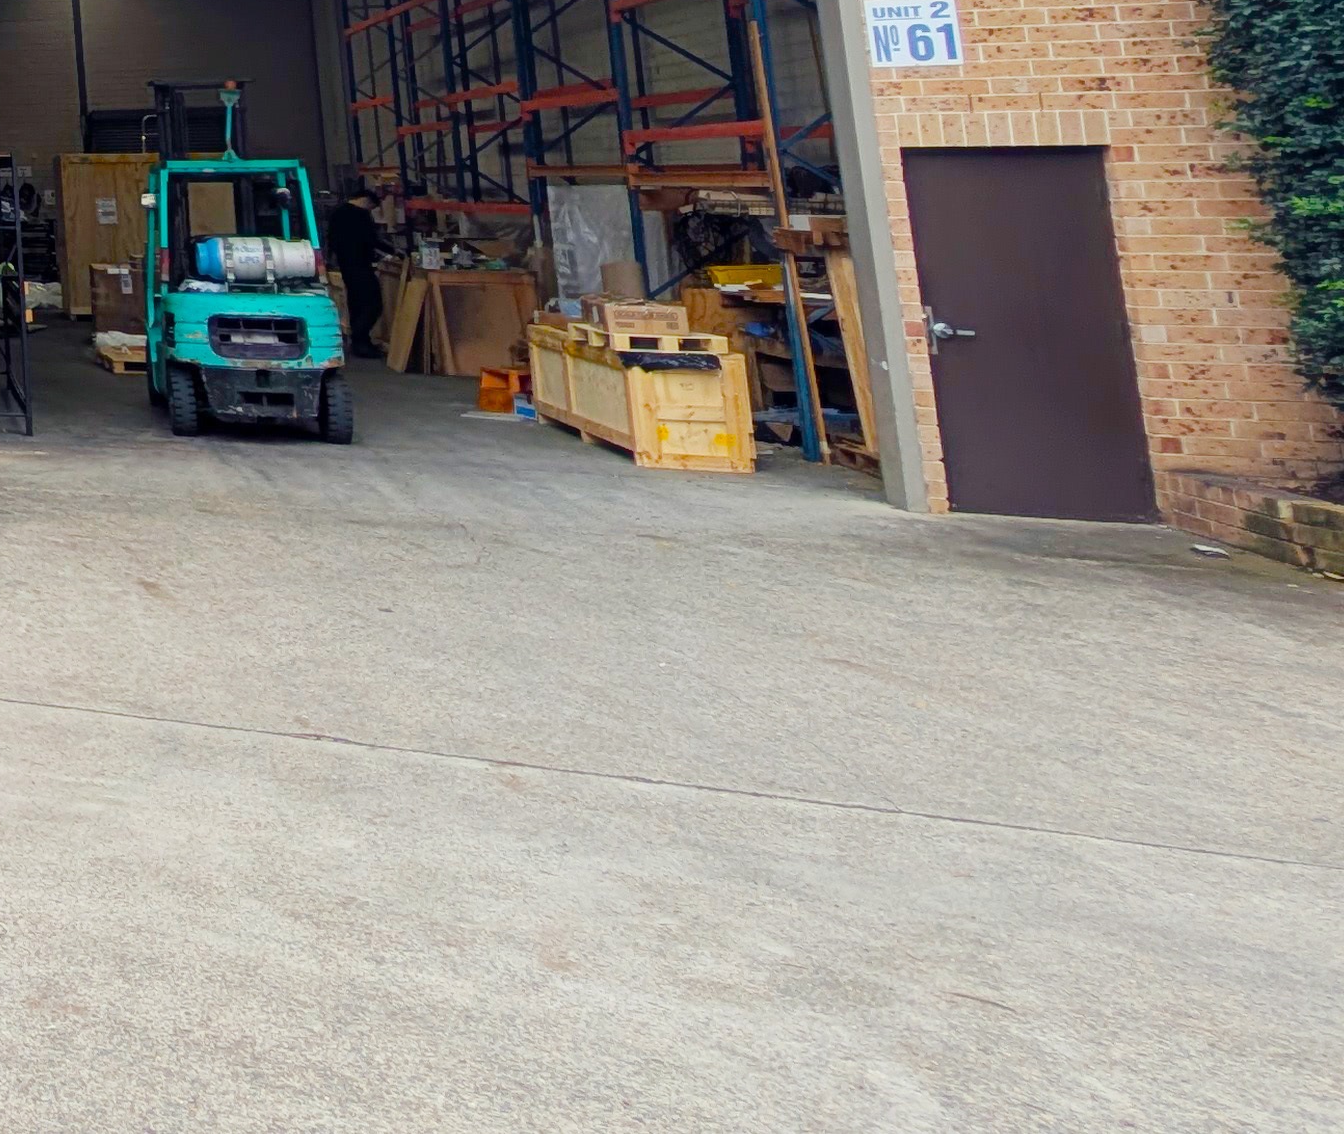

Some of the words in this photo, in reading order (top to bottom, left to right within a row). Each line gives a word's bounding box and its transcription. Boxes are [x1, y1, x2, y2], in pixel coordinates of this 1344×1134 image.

[872, 5, 922, 19] UNIT
[930, 0, 951, 19] 2
[906, 23, 958, 62] 61
